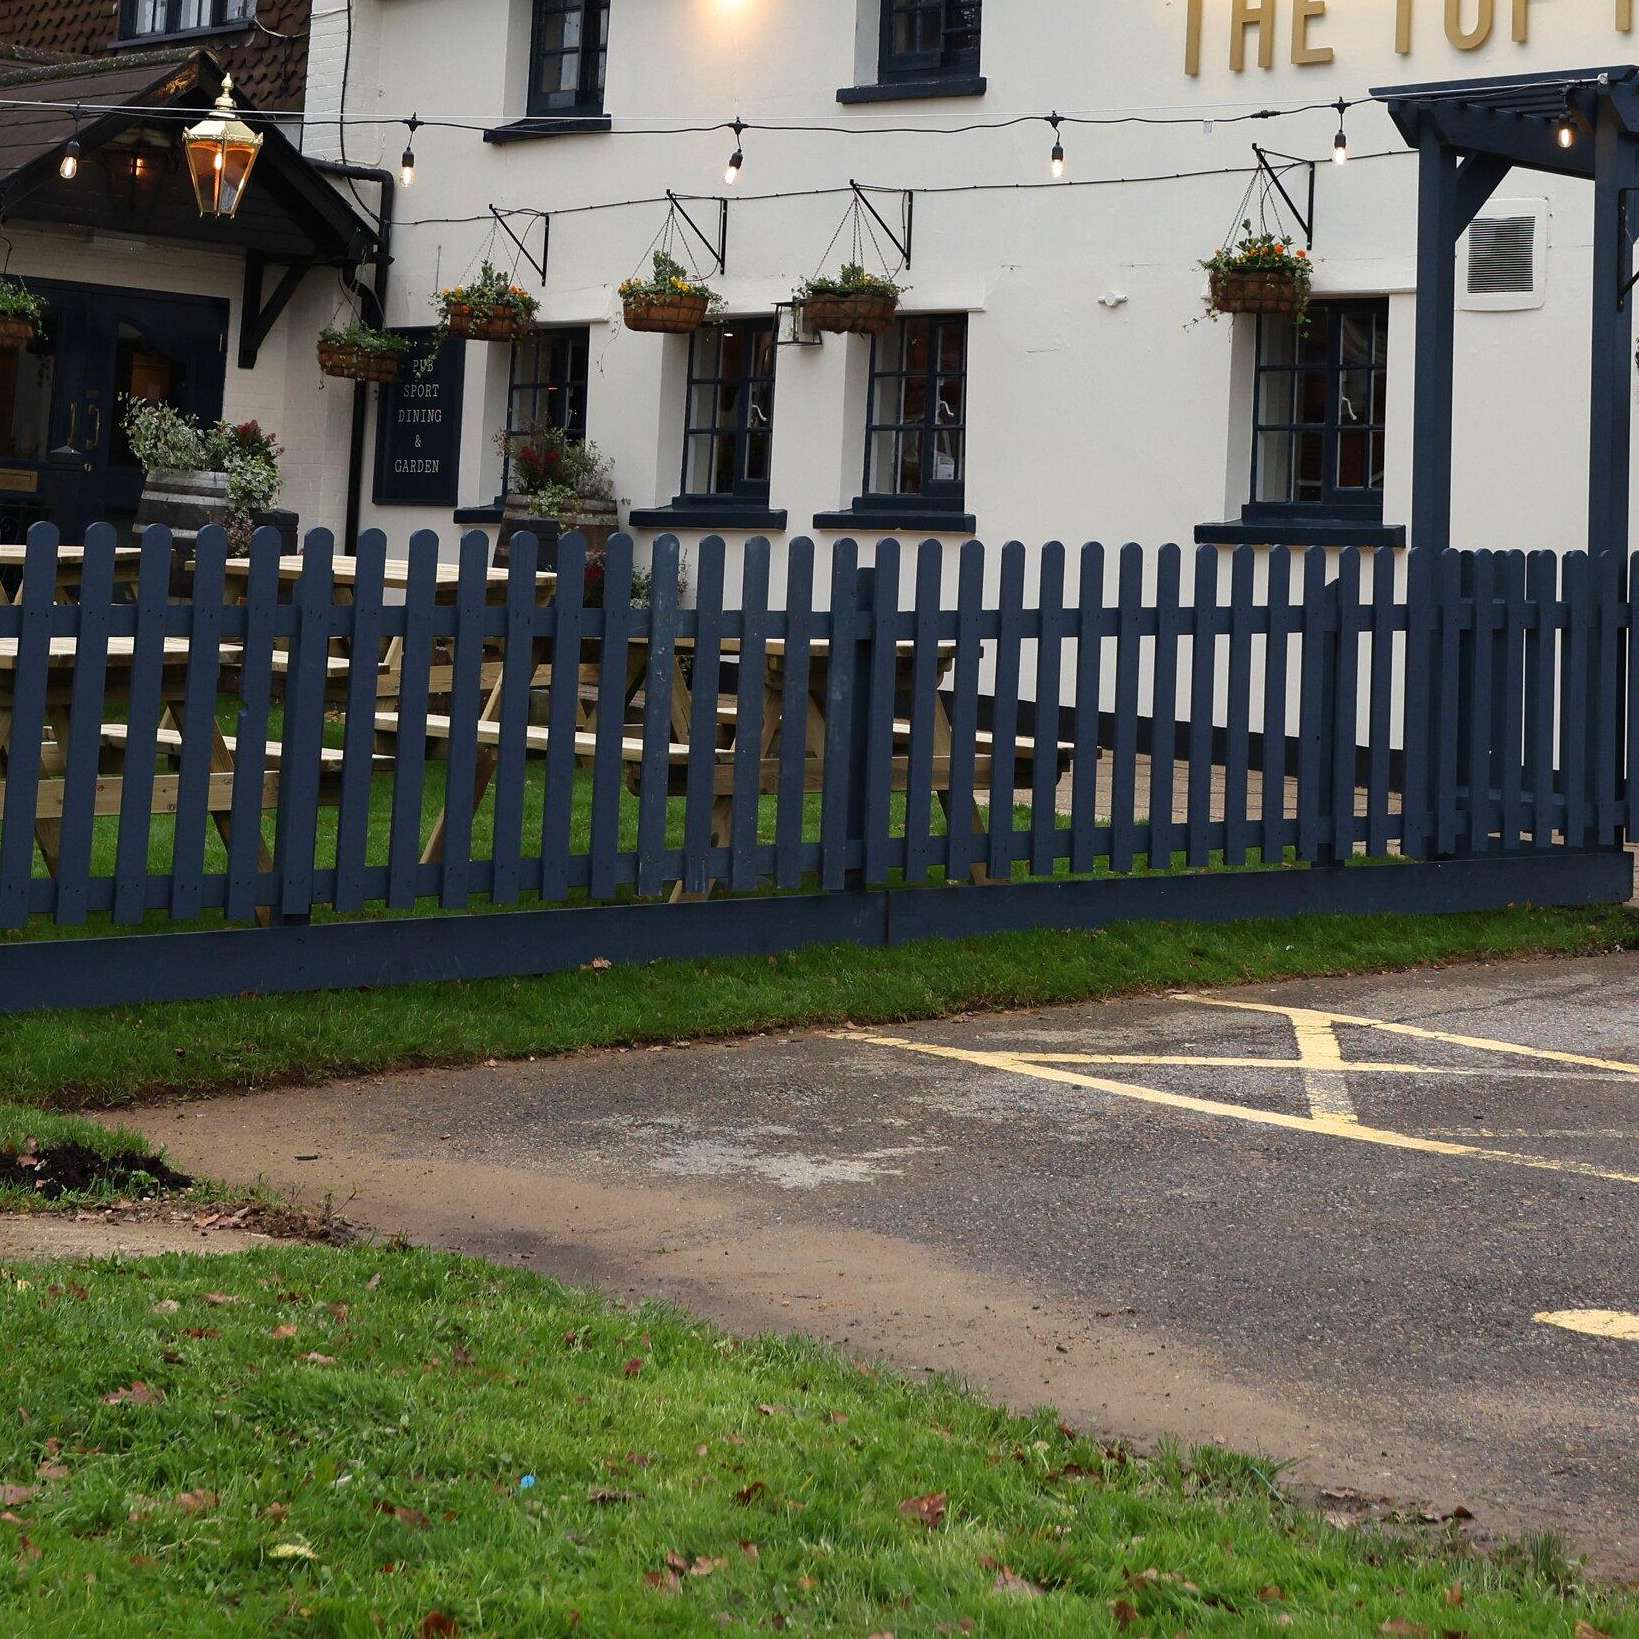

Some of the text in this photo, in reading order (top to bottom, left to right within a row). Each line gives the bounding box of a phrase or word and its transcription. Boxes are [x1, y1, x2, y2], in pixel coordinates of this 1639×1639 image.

[412, 359, 434, 373] PUB
[403, 384, 439, 398] SPORT
[398, 409, 442, 423] DINING
[414, 434, 422, 448] &
[394, 459, 440, 473] GARDEN
